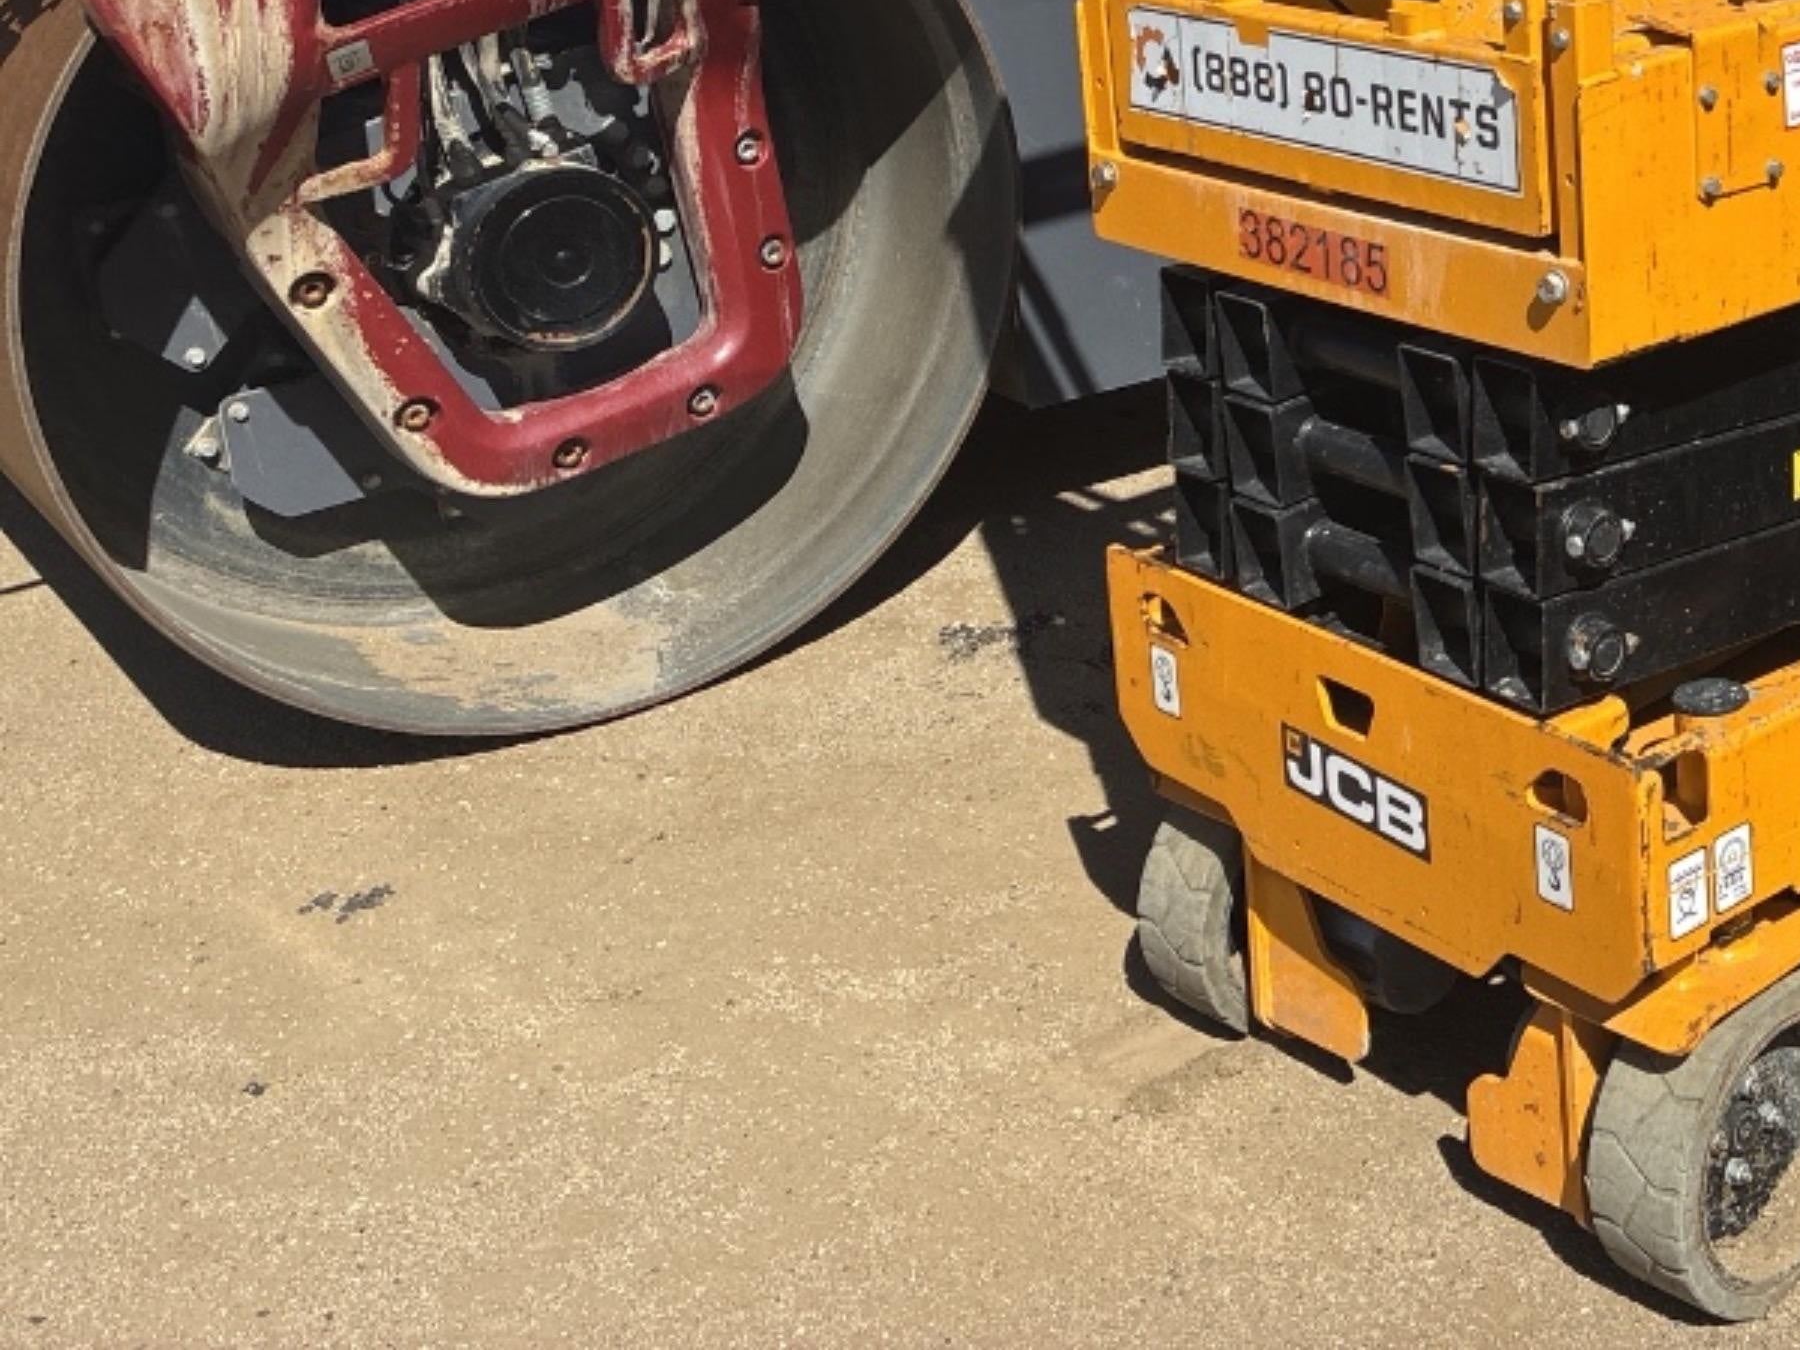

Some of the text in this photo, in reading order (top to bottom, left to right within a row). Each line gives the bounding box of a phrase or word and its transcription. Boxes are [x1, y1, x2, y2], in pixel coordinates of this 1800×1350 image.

[1193, 46, 1288, 109] (888)
[1240, 210, 1388, 294] 382185
[1287, 741, 1426, 852] JCB
